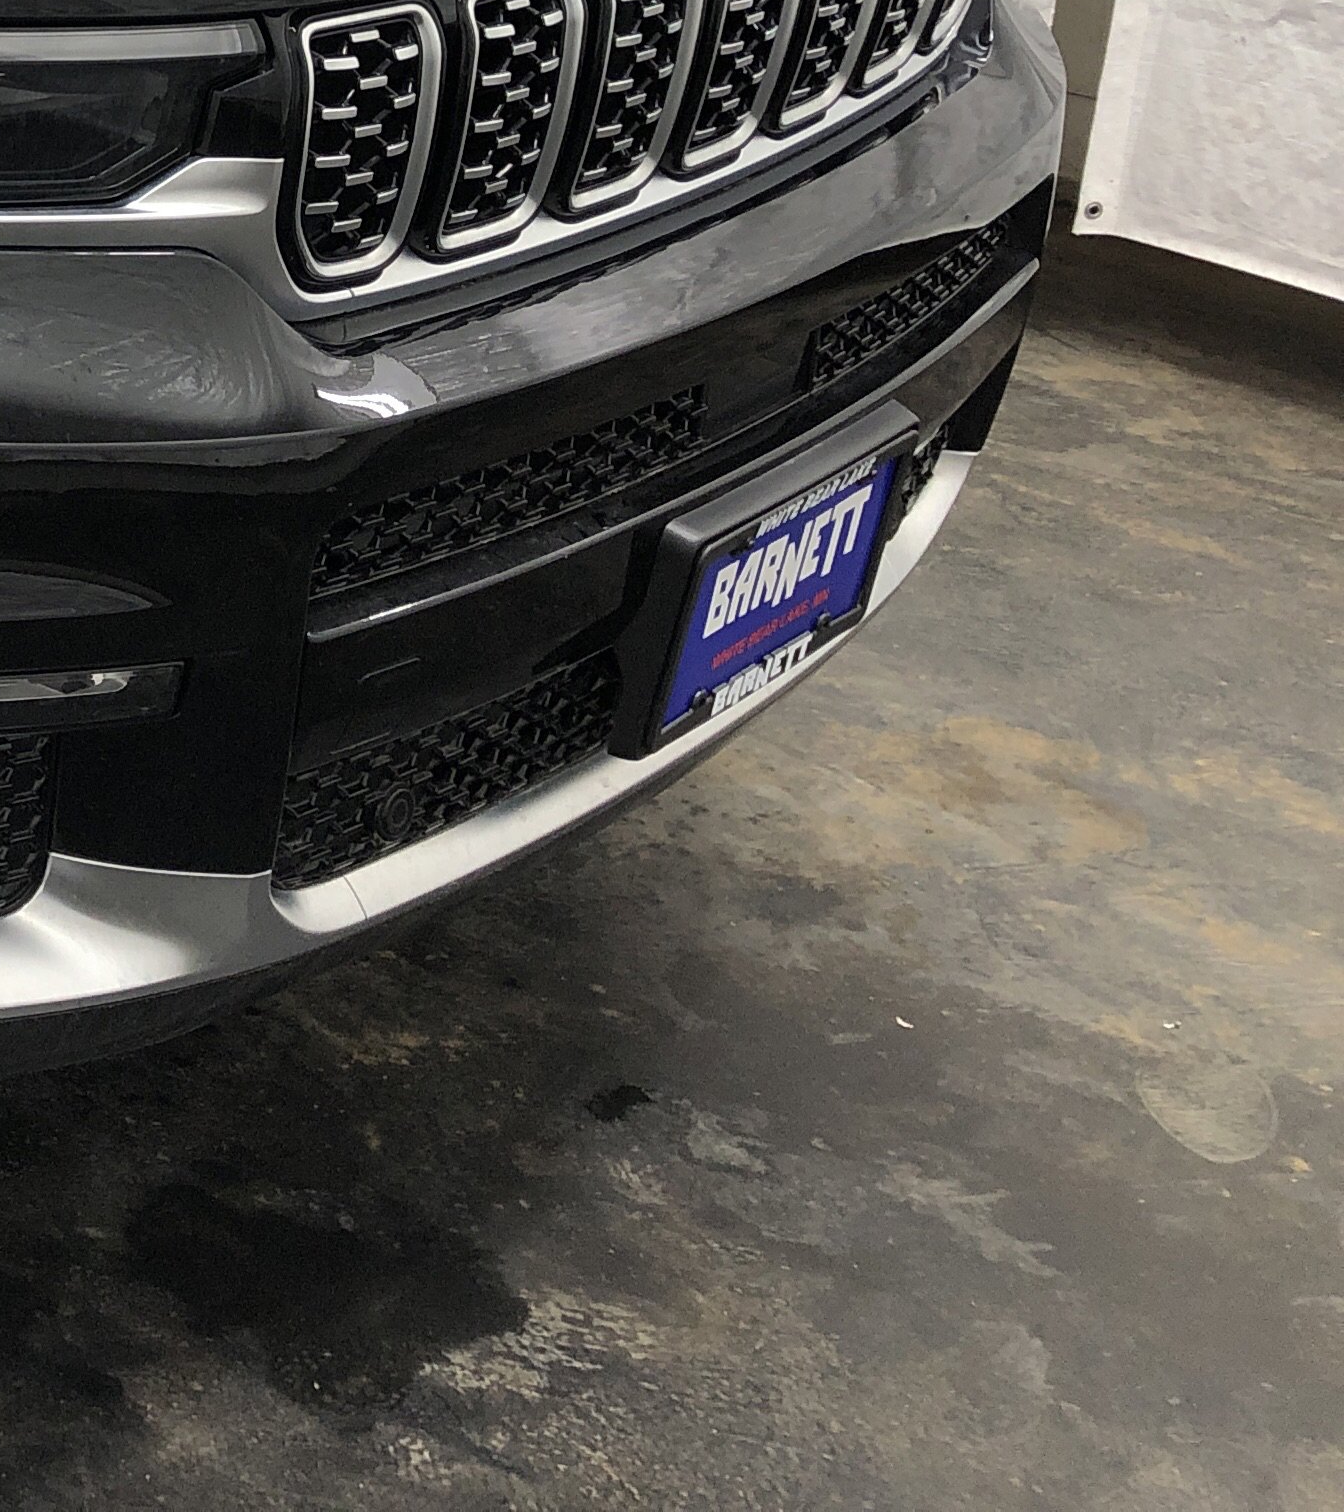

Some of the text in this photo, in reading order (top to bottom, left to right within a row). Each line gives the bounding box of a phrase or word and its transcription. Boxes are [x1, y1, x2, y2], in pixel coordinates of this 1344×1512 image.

[702, 483, 873, 639] BARNETT
[756, 499, 804, 539] WHITE
[711, 631, 814, 717] BARNETT
